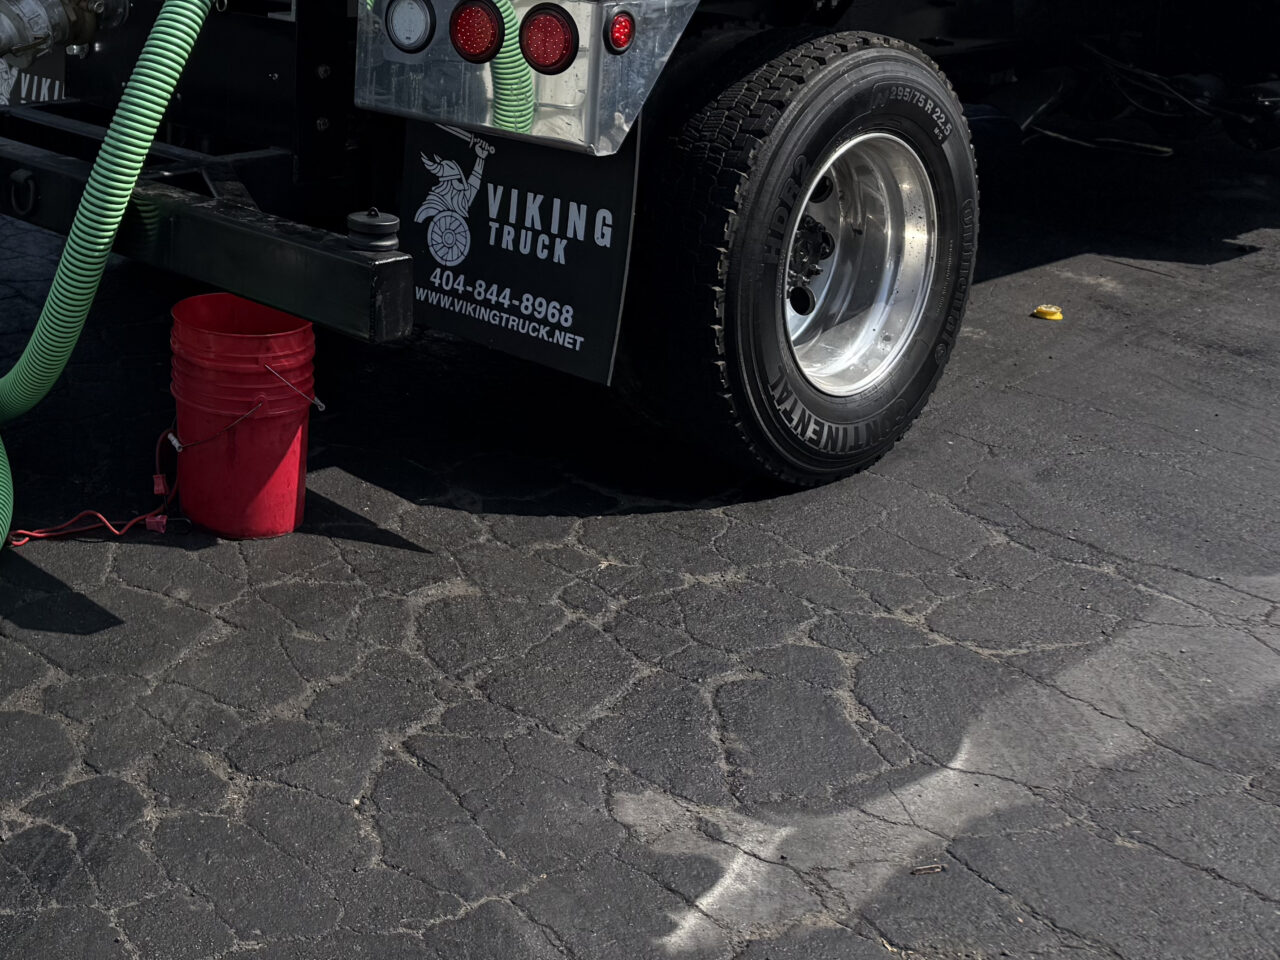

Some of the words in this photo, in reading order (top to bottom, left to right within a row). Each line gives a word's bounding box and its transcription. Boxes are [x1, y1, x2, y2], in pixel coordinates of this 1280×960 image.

[21, 72, 66, 101] VIKI
[889, 86, 926, 108] 295/75
[924, 99, 934, 114] R
[931, 107, 952, 136] 22.5
[487, 182, 614, 249] VIKING
[488, 221, 569, 265] TRUCK
[414, 286, 585, 352] WWW.VIKINGTRUCK.NET
[429, 267, 575, 328] 404-844-8968
